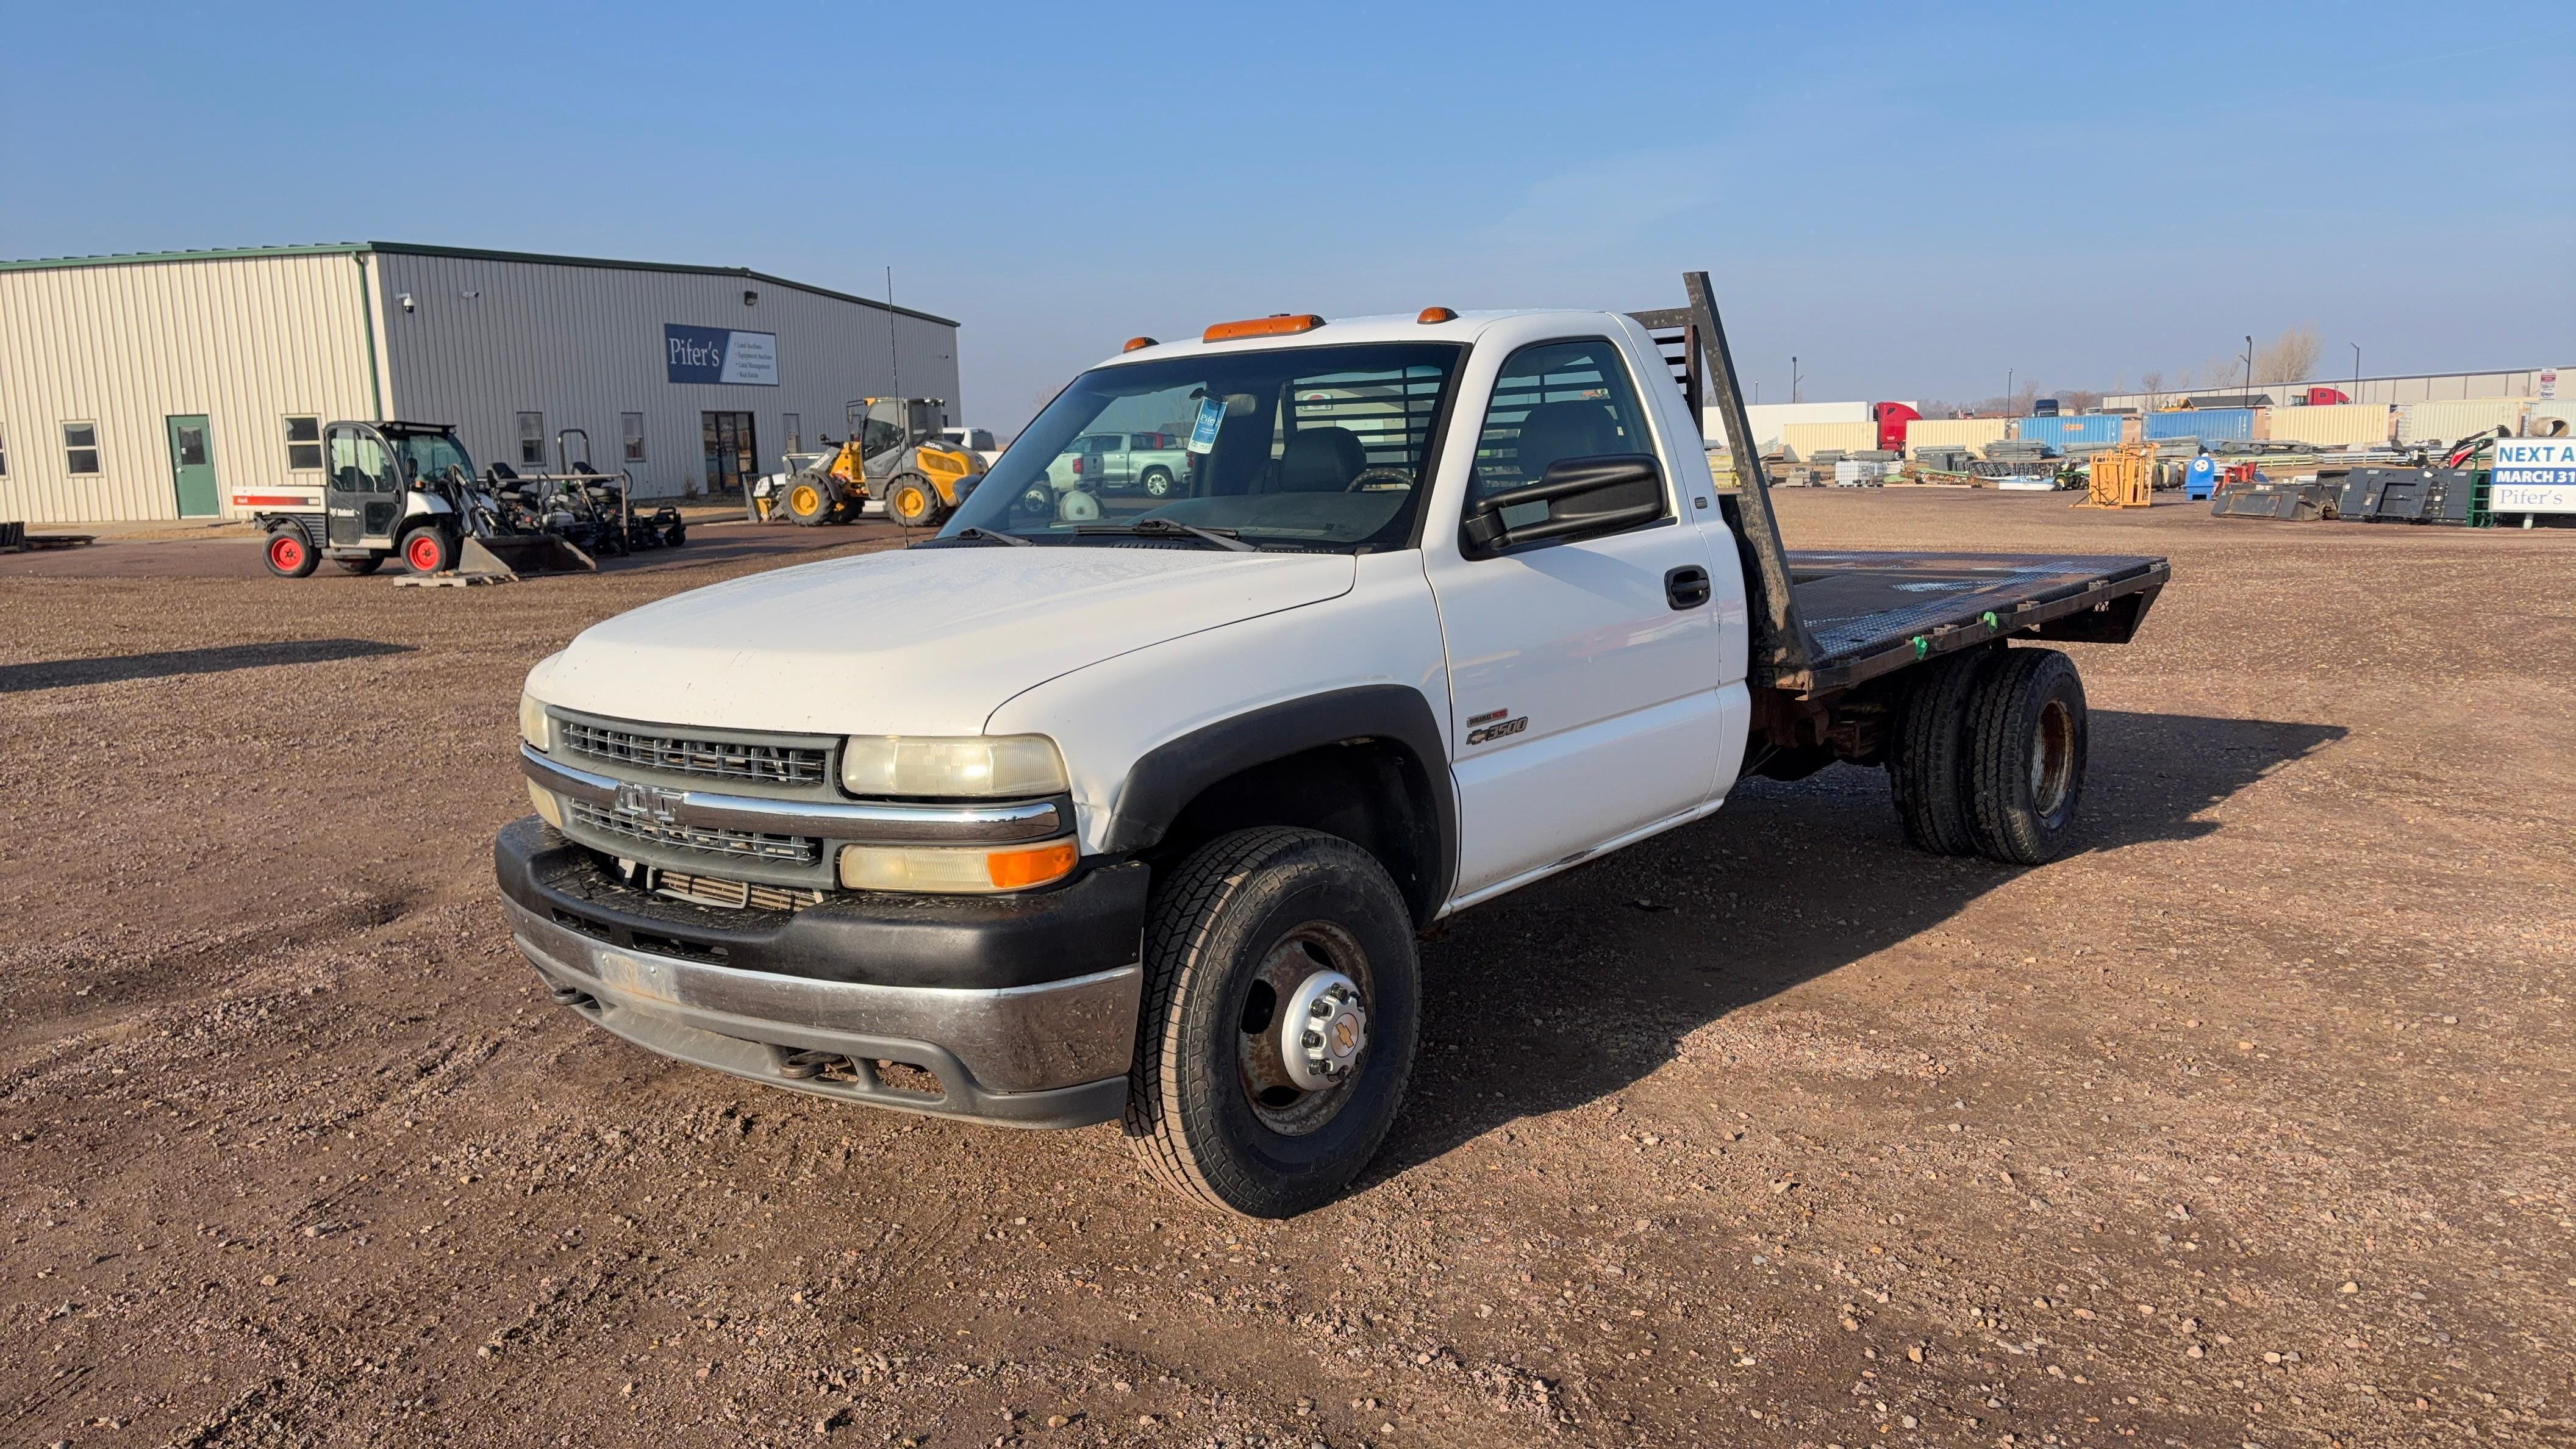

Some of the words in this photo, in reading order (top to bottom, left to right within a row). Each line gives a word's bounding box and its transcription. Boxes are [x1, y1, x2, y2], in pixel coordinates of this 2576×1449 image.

[669, 338, 720, 367] Pifer's
[2499, 446, 2556, 462] NEXT
[2496, 470, 2555, 483] MARCH
[2499, 489, 2564, 505] Pifer's
[1487, 717, 1528, 741] 3500
